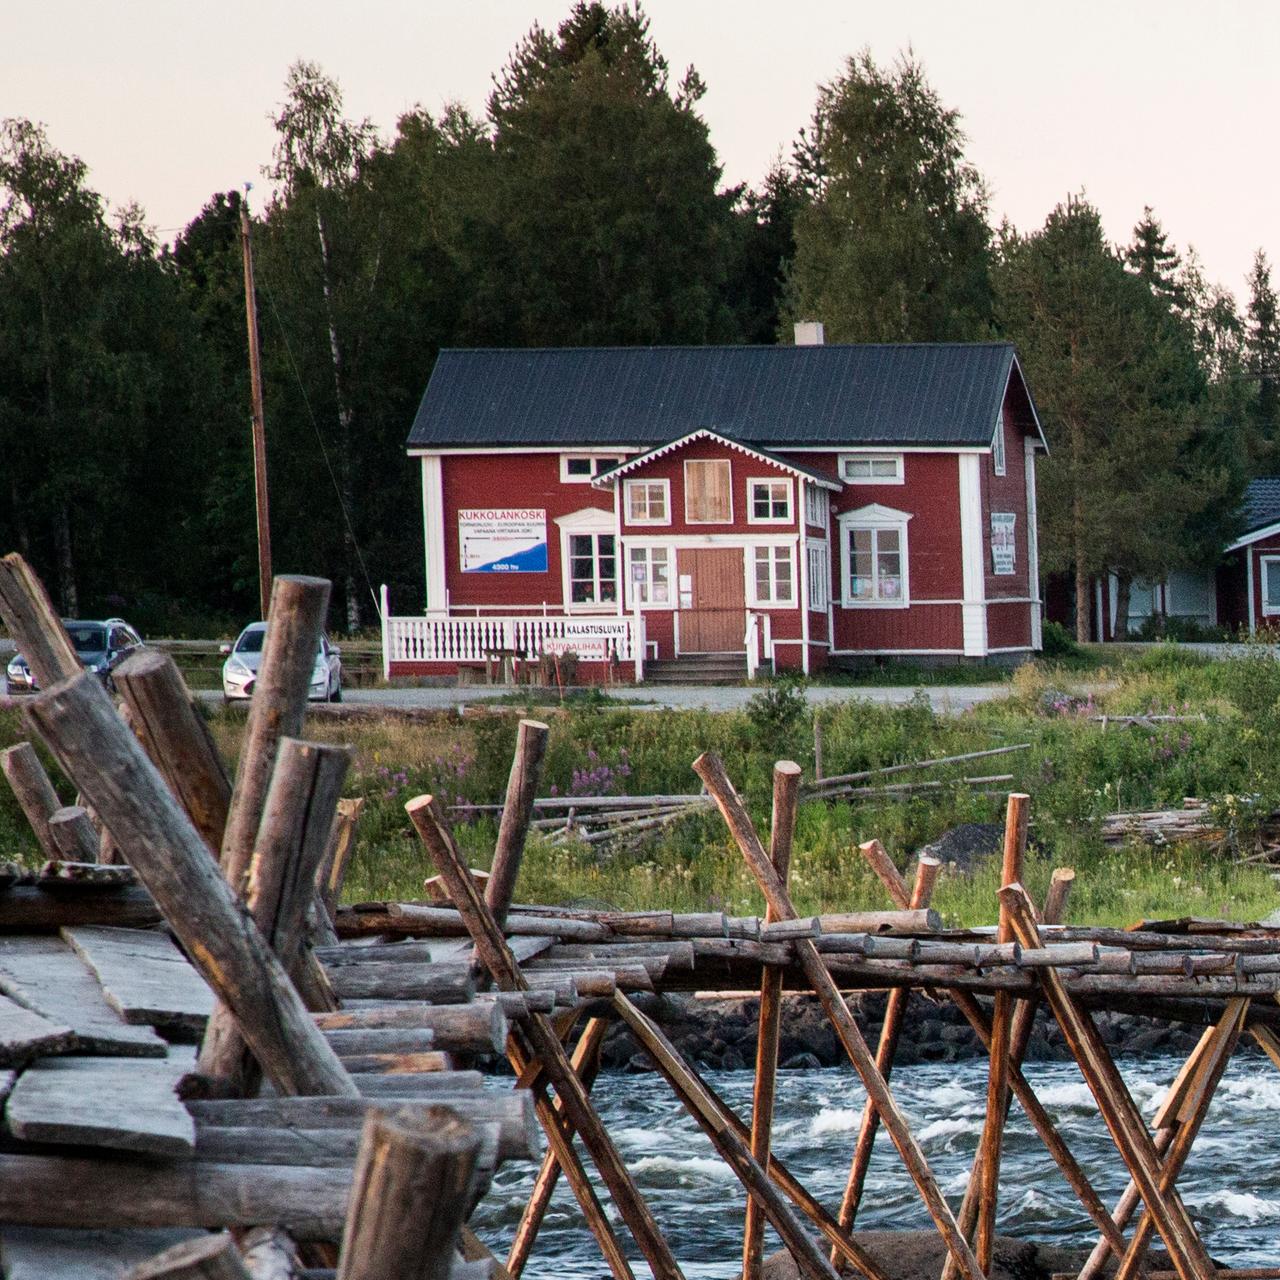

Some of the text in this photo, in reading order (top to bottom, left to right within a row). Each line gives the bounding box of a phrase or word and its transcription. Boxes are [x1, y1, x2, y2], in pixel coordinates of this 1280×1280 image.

[459, 511, 545, 520] KUKKOLANKOSKI
[567, 625, 625, 634] KALASTUSLUVAT
[546, 643, 602, 651] KUIVAALIHAA
